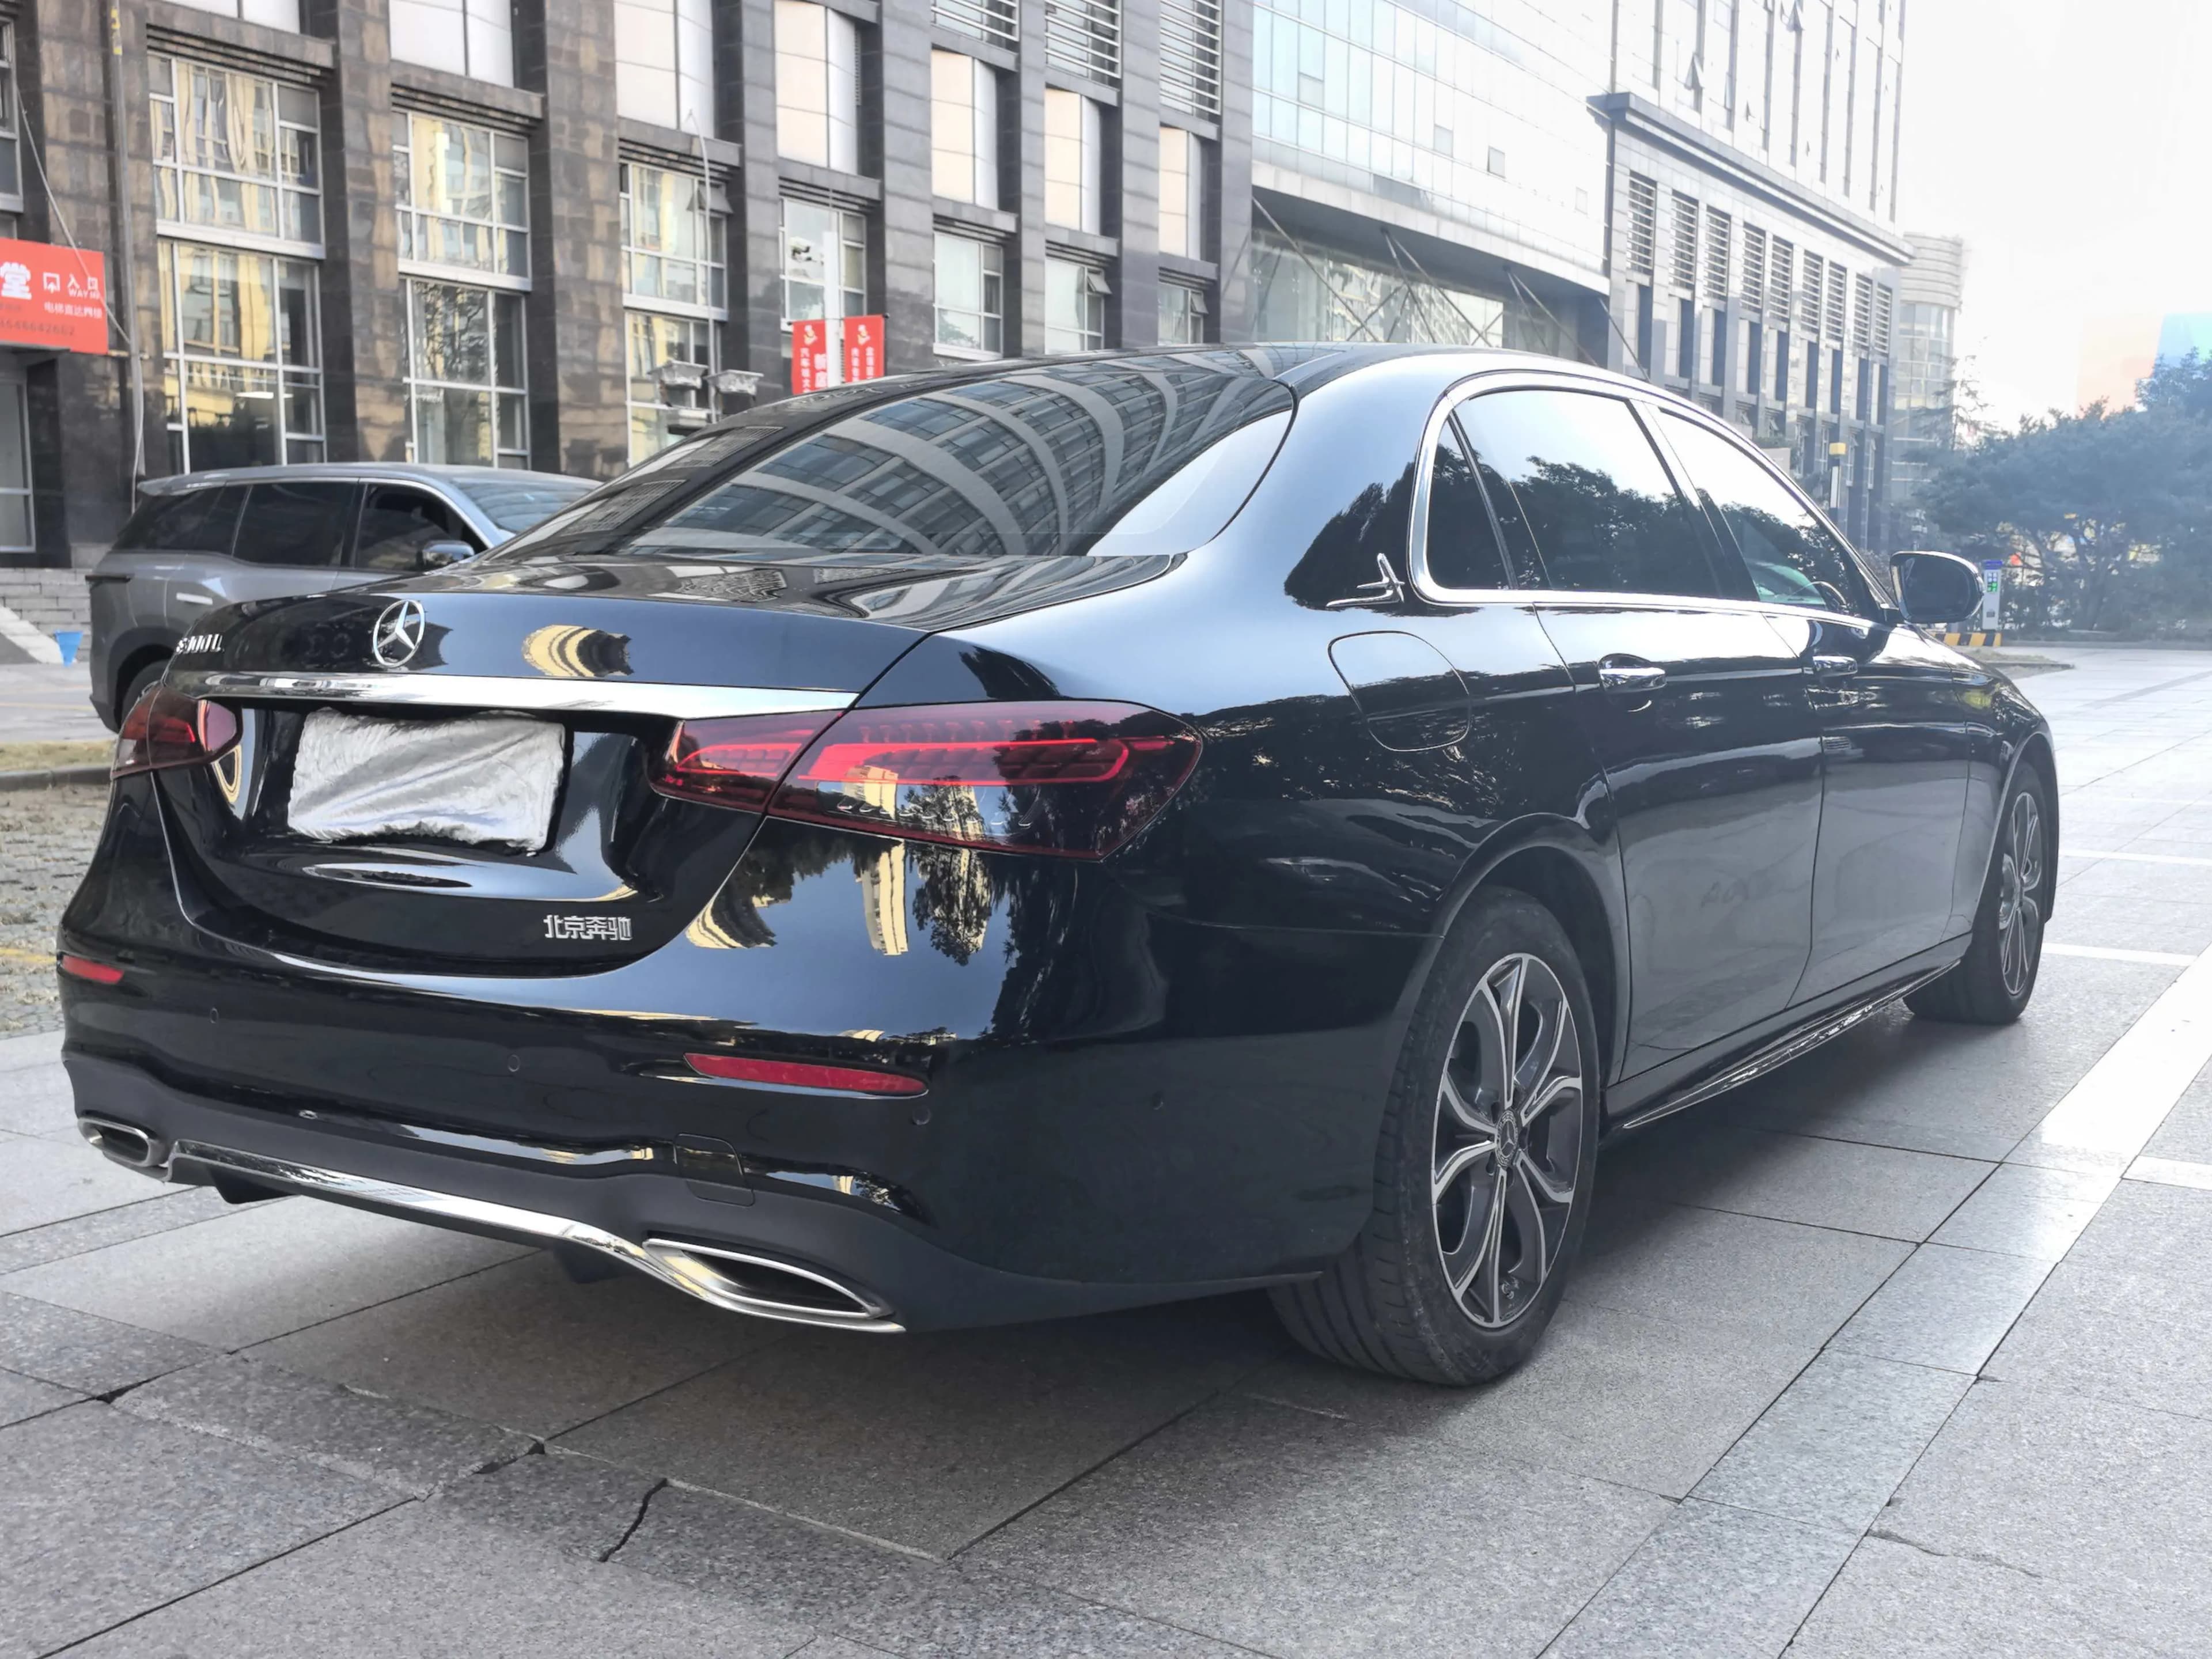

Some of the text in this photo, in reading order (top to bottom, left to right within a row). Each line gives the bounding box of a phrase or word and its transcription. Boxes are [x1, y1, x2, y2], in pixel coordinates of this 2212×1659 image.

[0, 262, 32, 300] 堂
[68, 288, 88, 300] WAY
[543, 915, 633, 940] 北京奔驰
